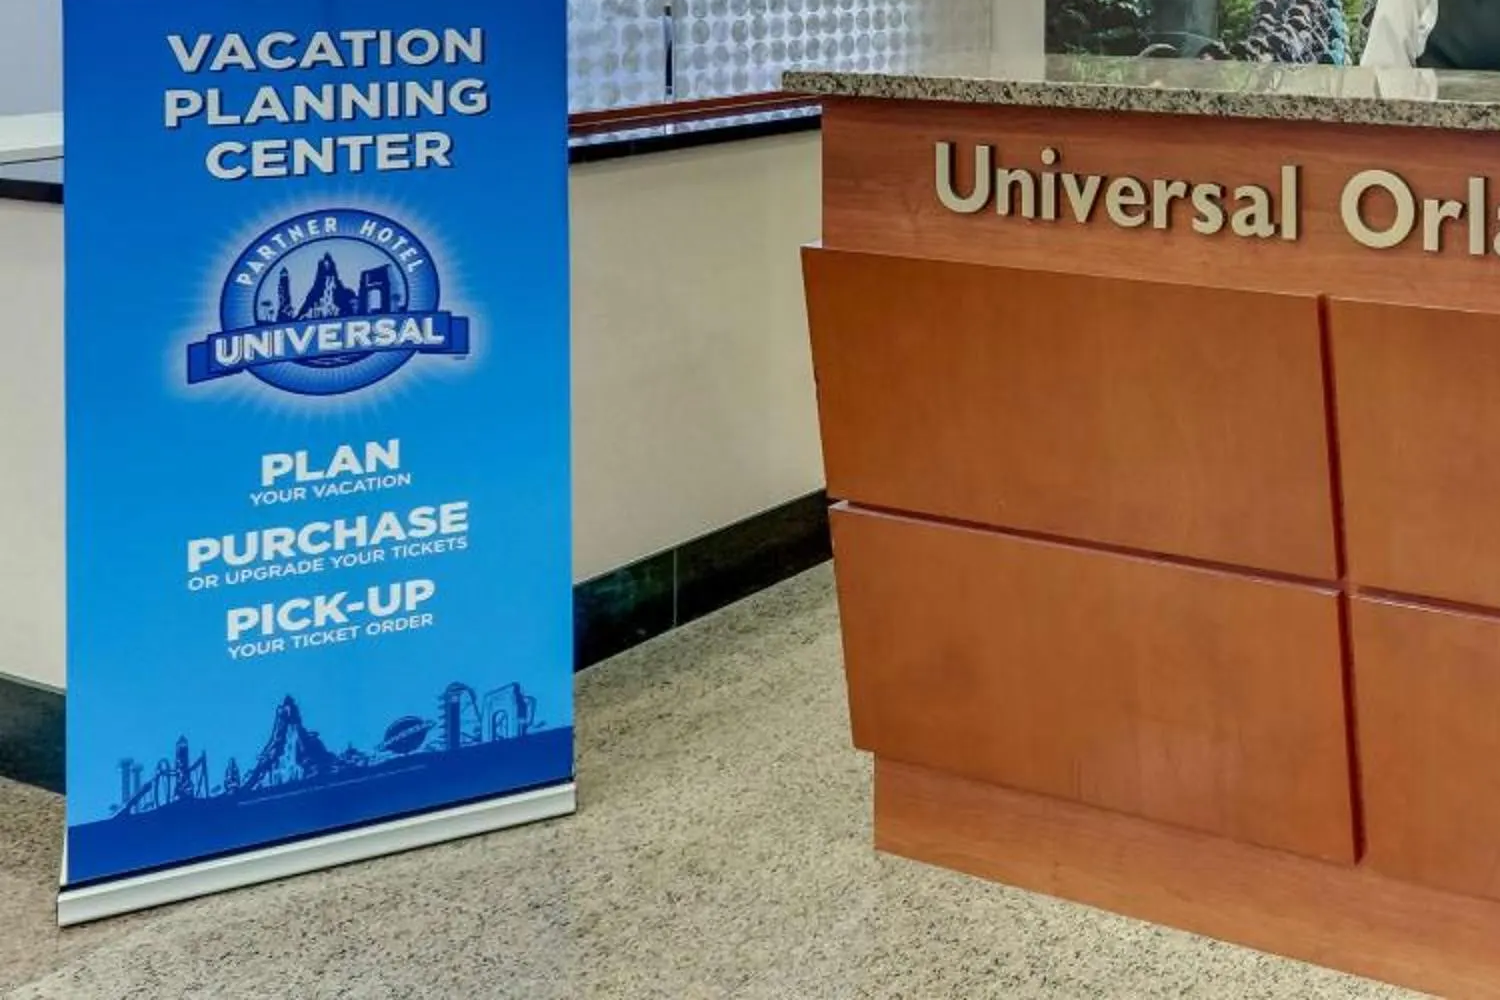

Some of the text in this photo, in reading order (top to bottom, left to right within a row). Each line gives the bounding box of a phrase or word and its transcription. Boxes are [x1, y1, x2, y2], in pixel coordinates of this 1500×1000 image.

[166, 27, 485, 73] VACATION
[164, 78, 489, 128] PLANNING
[205, 131, 454, 180] CENTER
[934, 140, 1299, 240] Universal
[235, 217, 425, 286] PARTNER HOTEL
[215, 317, 445, 367] UNIVERSAL
[261, 438, 401, 487] PLAN
[250, 472, 412, 507] YOUR VACATION
[186, 500, 470, 572] PURCHASE
[187, 534, 468, 592] OR UPGRADE YOUR TICKETS
[226, 578, 436, 642] PICK-UP
[227, 611, 435, 660] YOUR TICKET ORDER
